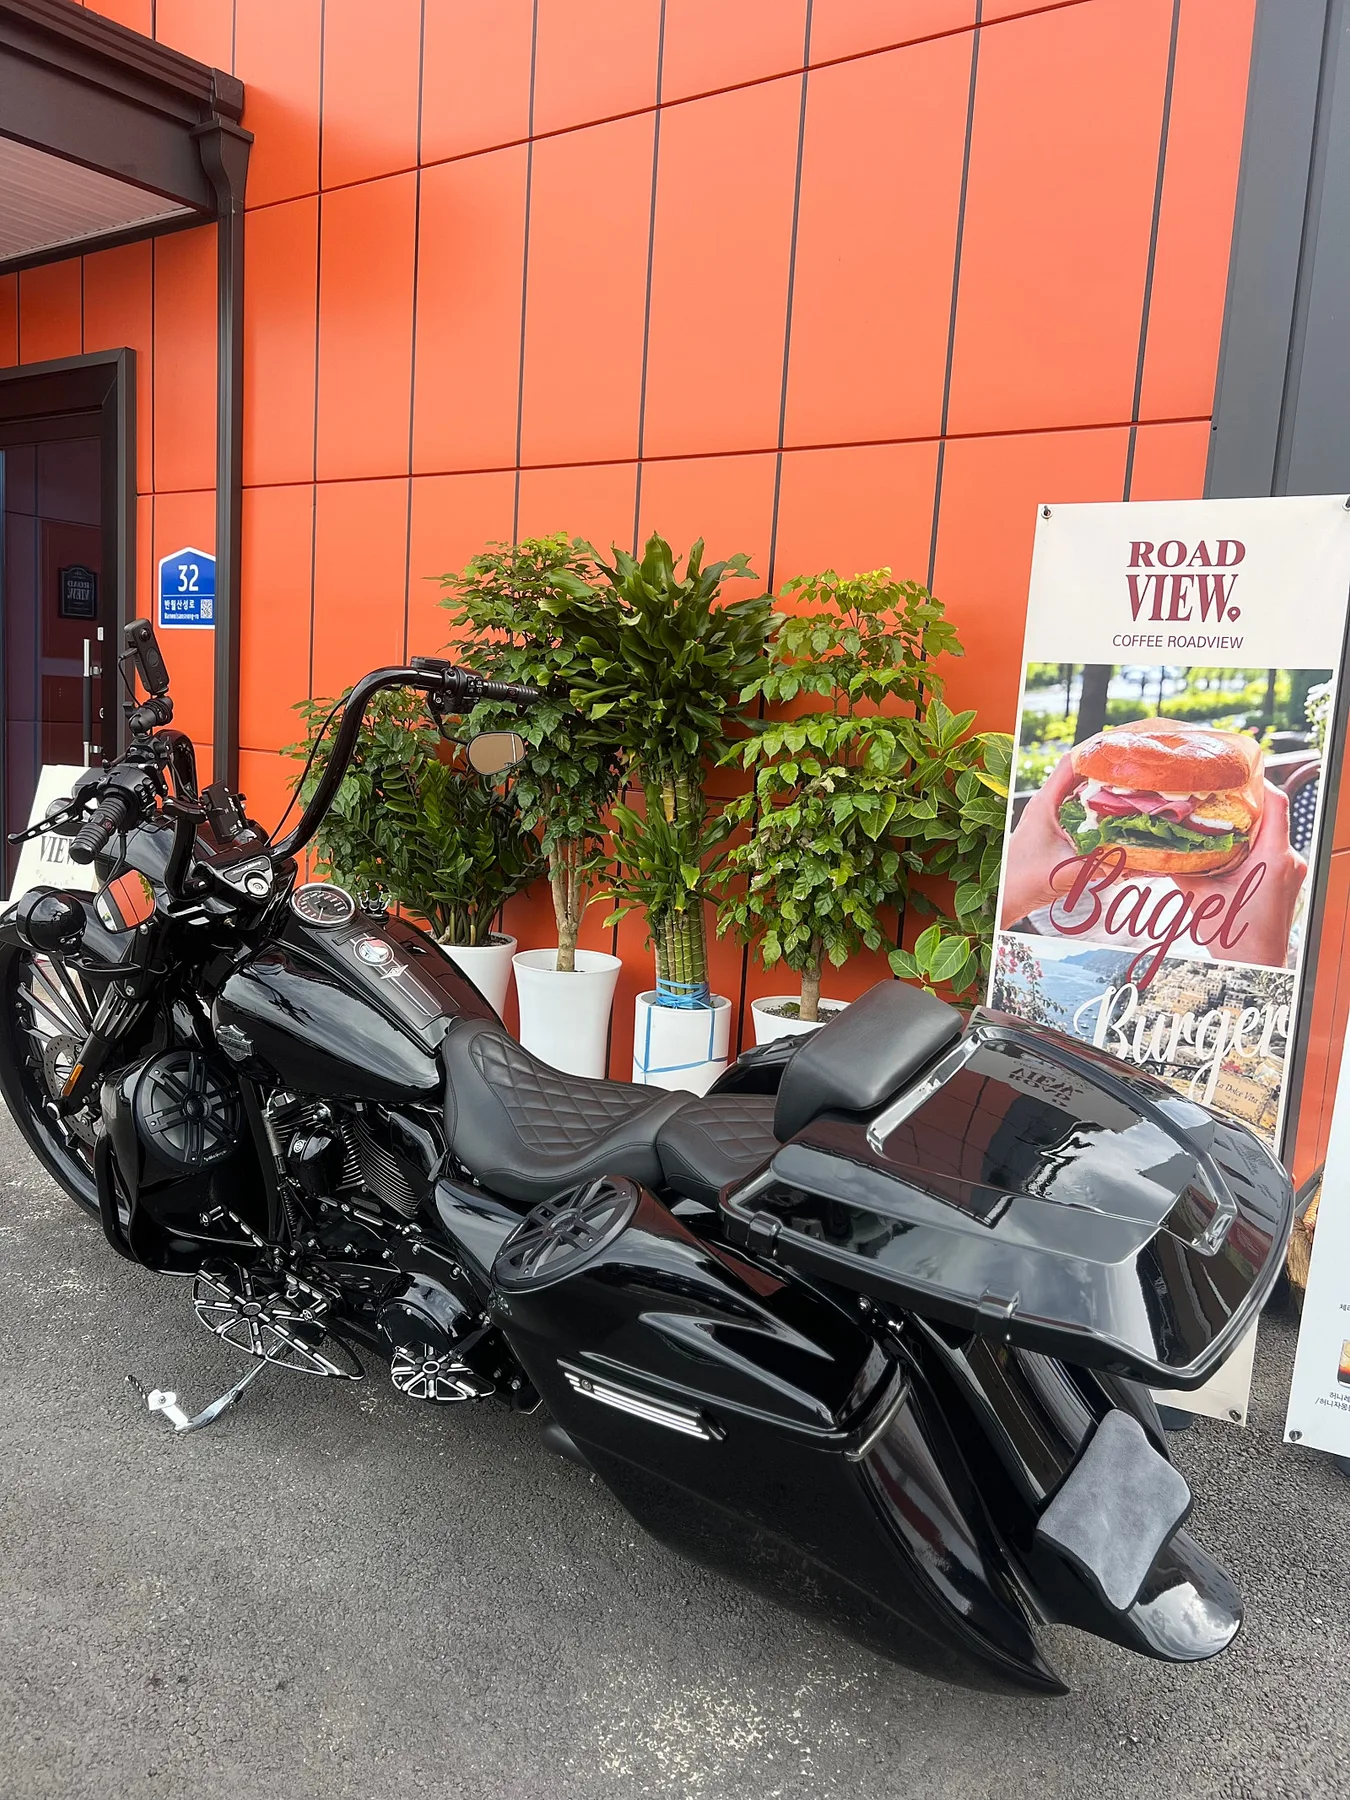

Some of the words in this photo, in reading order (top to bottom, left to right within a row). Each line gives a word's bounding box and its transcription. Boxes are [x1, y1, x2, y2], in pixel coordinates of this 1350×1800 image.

[1126, 539, 1246, 568] ROAD
[177, 564, 199, 592] 32
[1112, 634, 1164, 647] COFFEE
[1167, 635, 1244, 649] ROADVIEW
[40, 835, 80, 866] VIE
[1049, 847, 1267, 991] Bagel
[1073, 983, 1290, 1107] Burger
[1215, 1080, 1224, 1089] La
[1225, 1083, 1243, 1098] Dolce
[1244, 1092, 1259, 1104] Vita
